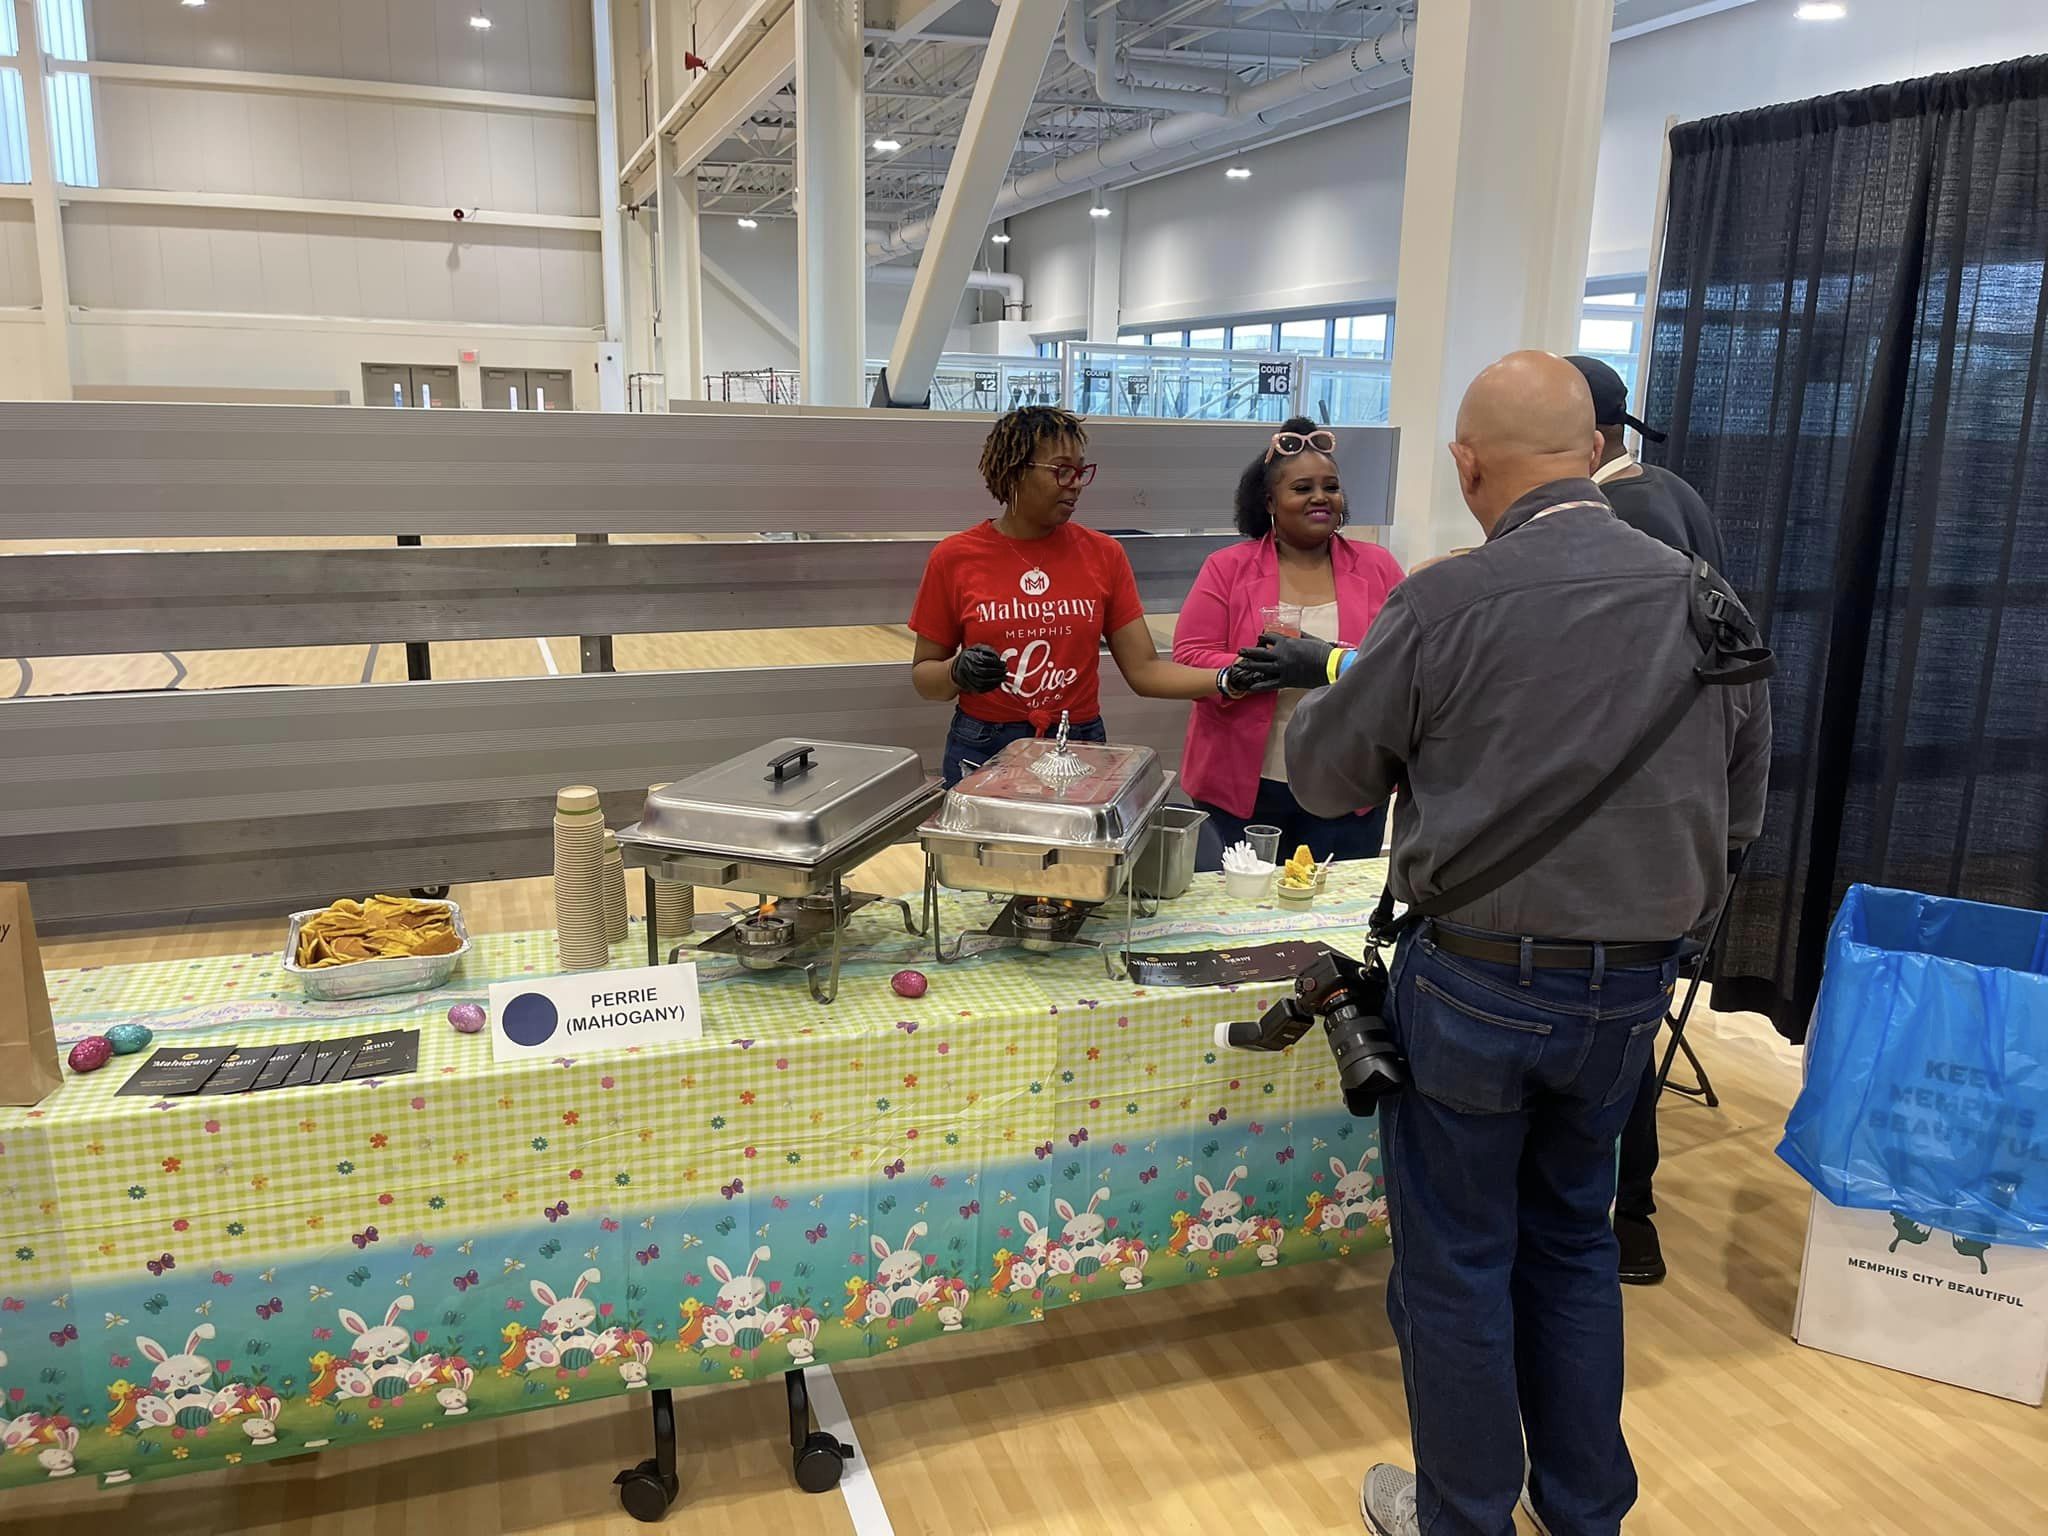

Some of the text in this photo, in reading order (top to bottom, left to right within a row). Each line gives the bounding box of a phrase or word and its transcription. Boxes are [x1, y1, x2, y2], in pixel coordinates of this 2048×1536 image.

[1260, 365, 1289, 374] COURT
[981, 379, 996, 391] 12
[1098, 378, 1107, 391] 9
[1134, 383, 1148, 394] 12
[1267, 375, 1288, 393] 16
[976, 597, 1096, 625] Mahogany
[1005, 625, 1073, 639] MEMPHIS
[591, 987, 658, 1009] PERRIE
[566, 1005, 686, 1036] (MAHOGANY)
[152, 1058, 216, 1068] Mahogany
[1924, 1059, 1997, 1089] KEE
[1868, 1109, 2048, 1161] BEAUTIUL
[1847, 1256, 2025, 1307] MEMPHIS CITY BEAUTIFUL
